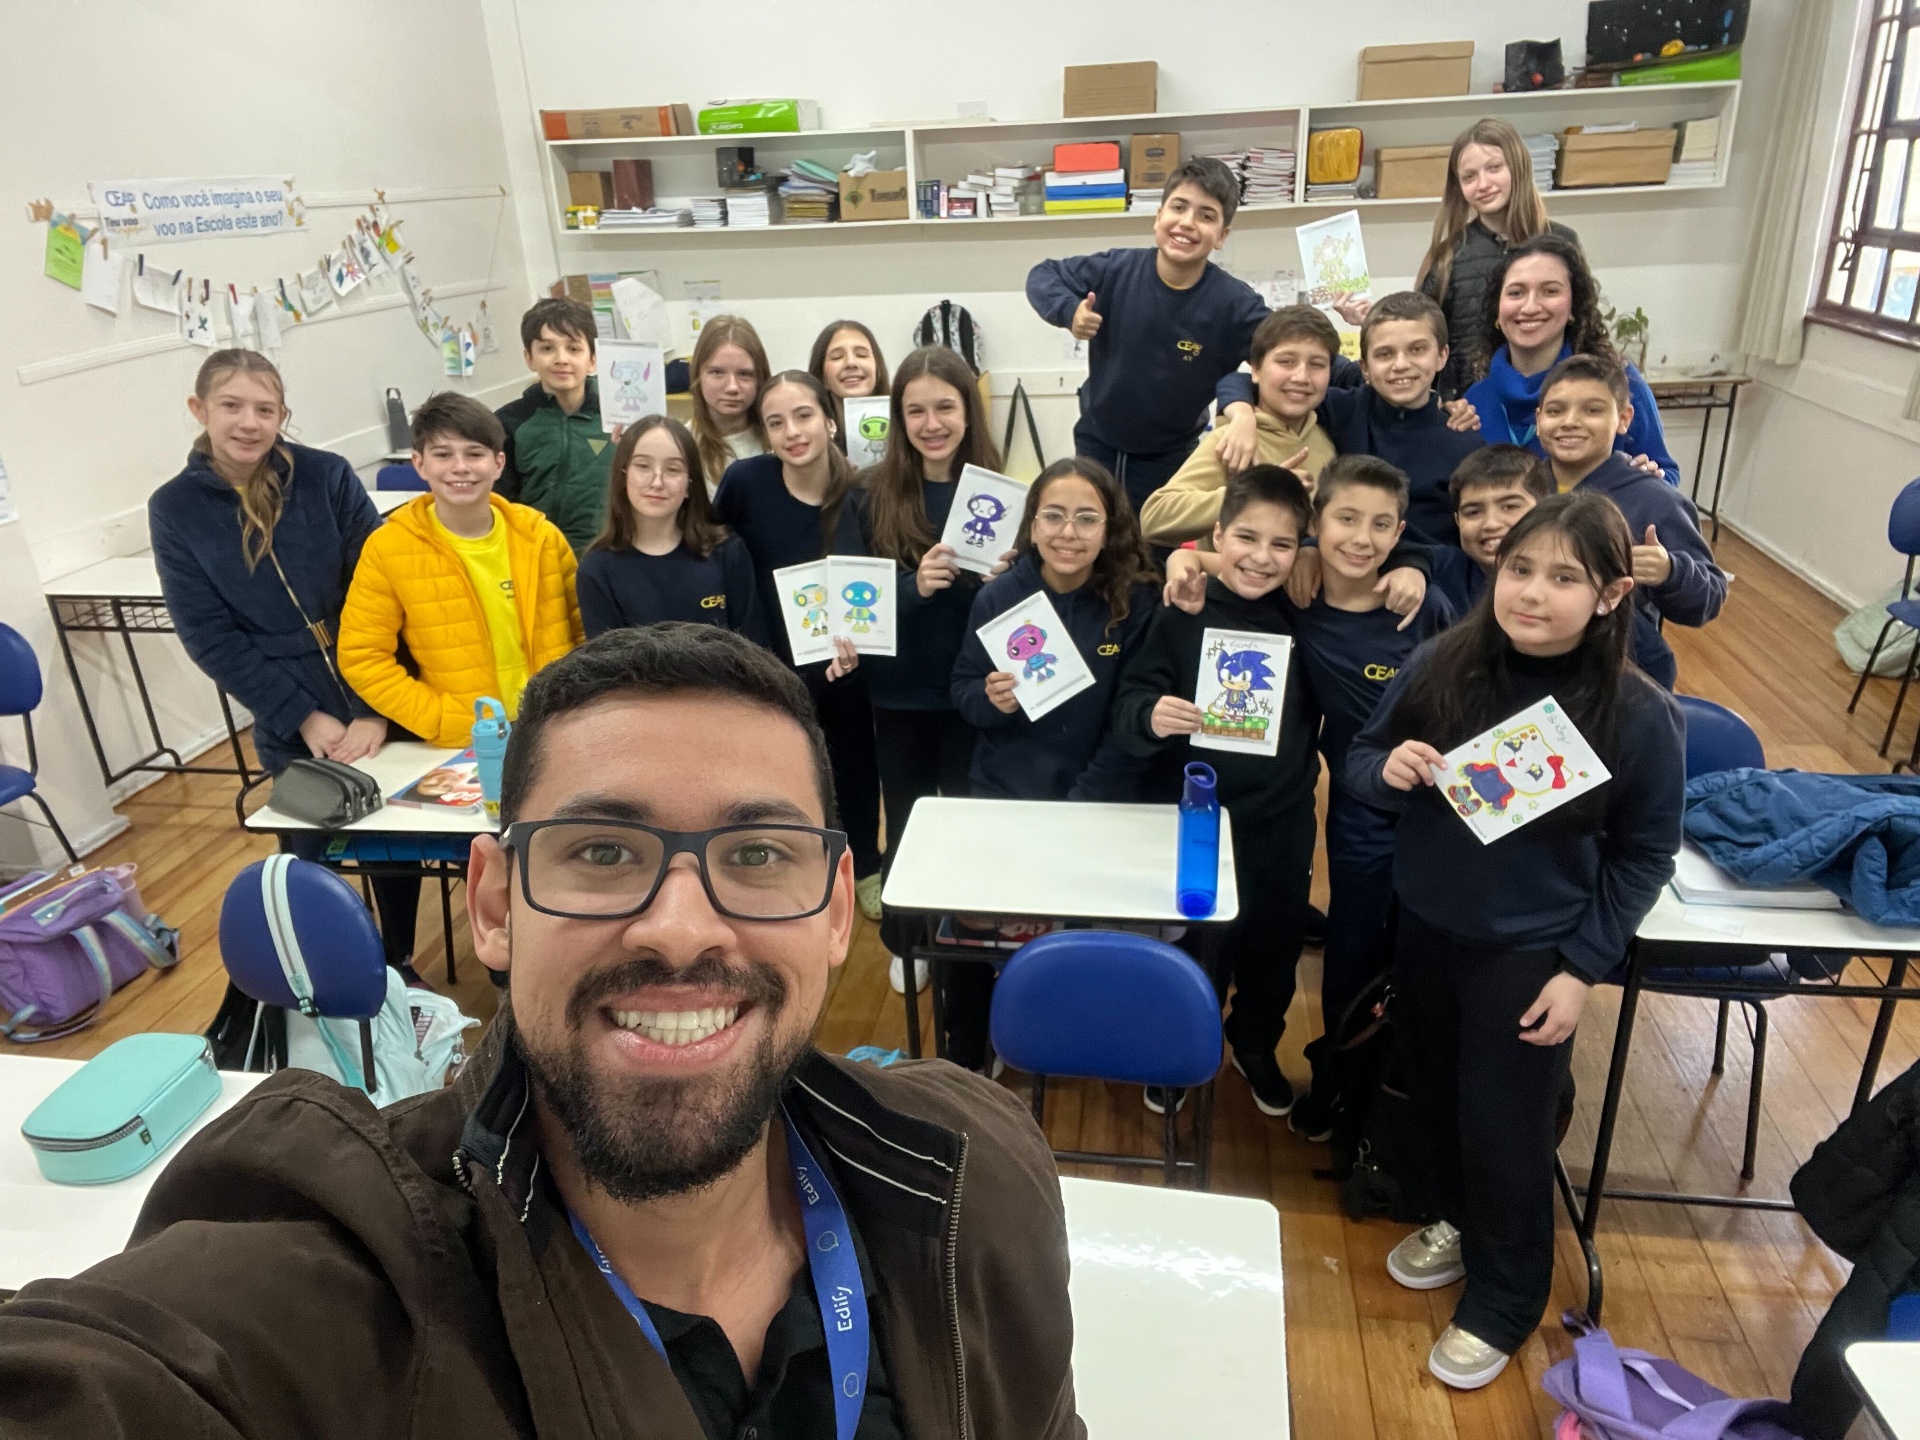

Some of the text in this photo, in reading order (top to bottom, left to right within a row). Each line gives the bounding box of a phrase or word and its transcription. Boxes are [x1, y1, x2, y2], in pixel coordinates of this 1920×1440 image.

[142, 189, 283, 210] Como você imagina o seu
[153, 221, 176, 236] voo
[178, 221, 194, 234] na
[195, 214, 233, 233] Escola
[236, 214, 258, 229] este
[260, 210, 284, 227] ano?
[797, 1166, 820, 1205] Edify
[830, 1286, 853, 1331] Edify
